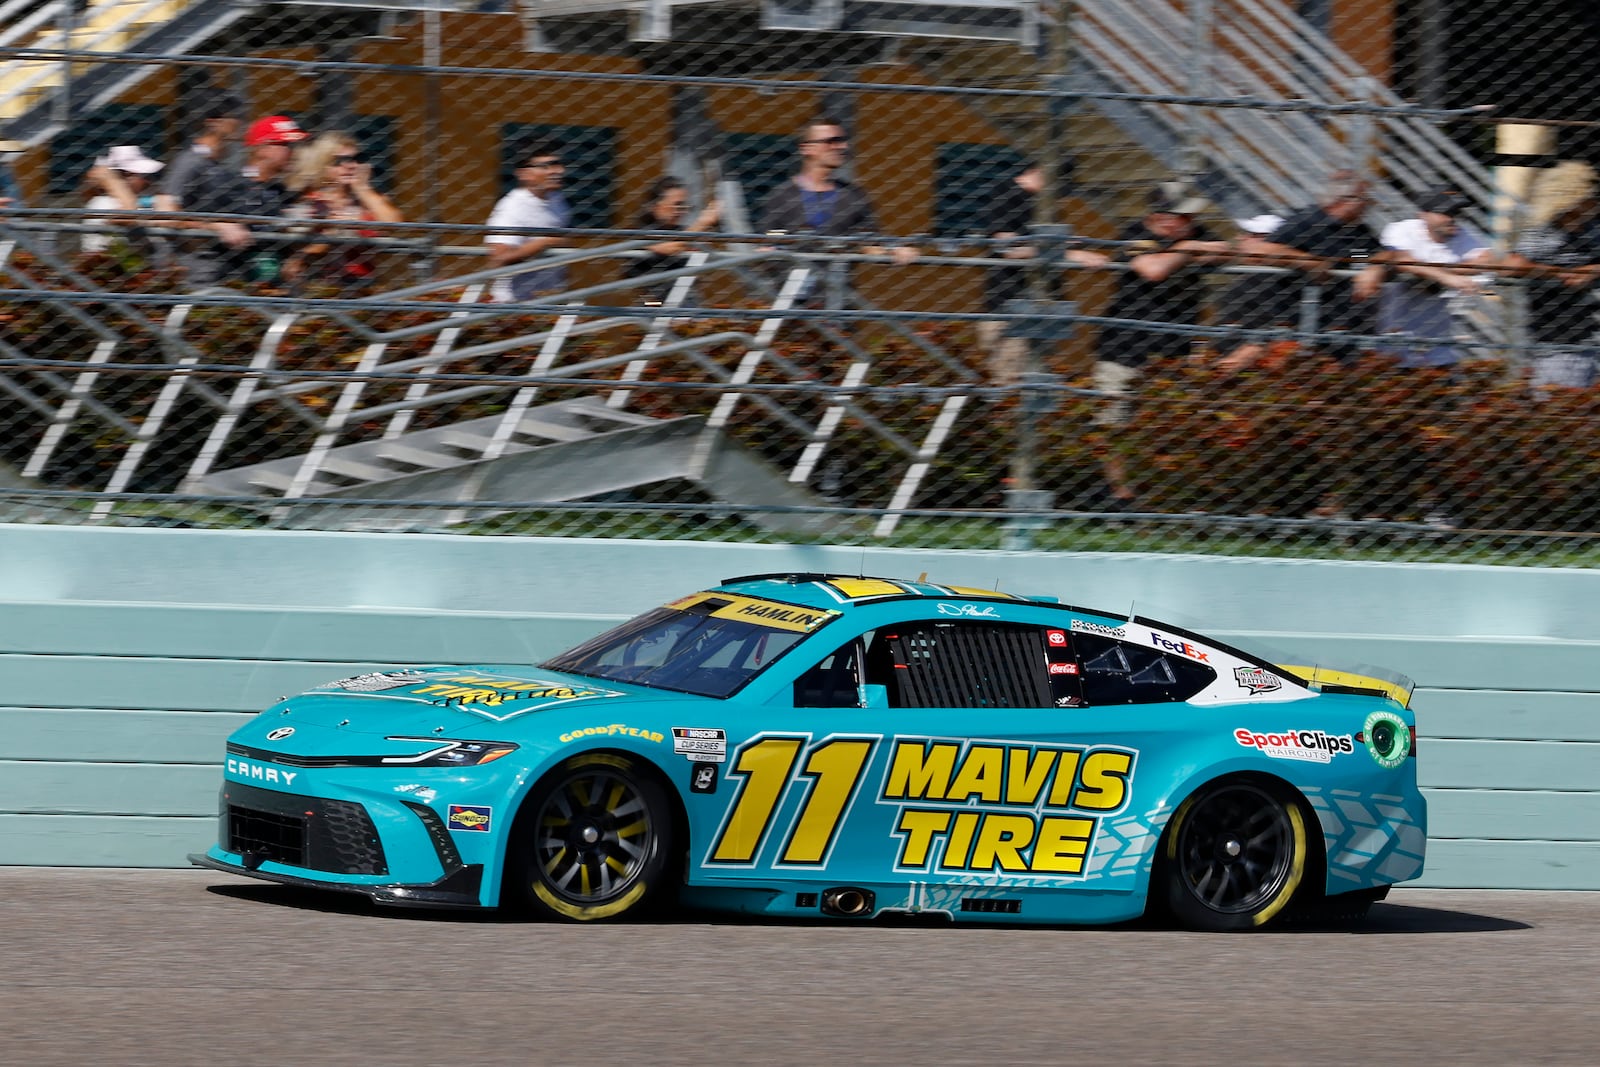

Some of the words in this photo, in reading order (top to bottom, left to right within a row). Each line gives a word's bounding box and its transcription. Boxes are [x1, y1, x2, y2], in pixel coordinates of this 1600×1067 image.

[737, 604, 822, 626] HAMLIN
[1151, 632, 1210, 663] FedEx
[559, 723, 664, 743] GOODYEAR
[690, 730, 718, 738] NASCAR
[696, 742, 719, 750] SERIES
[1268, 747, 1327, 760] HAIRCUTS
[227, 759, 297, 785] CAMRY
[883, 740, 1133, 811] MAVIS
[710, 736, 875, 866] 11
[452, 814, 488, 823] SUNOCO
[900, 810, 1095, 874] TIRE
